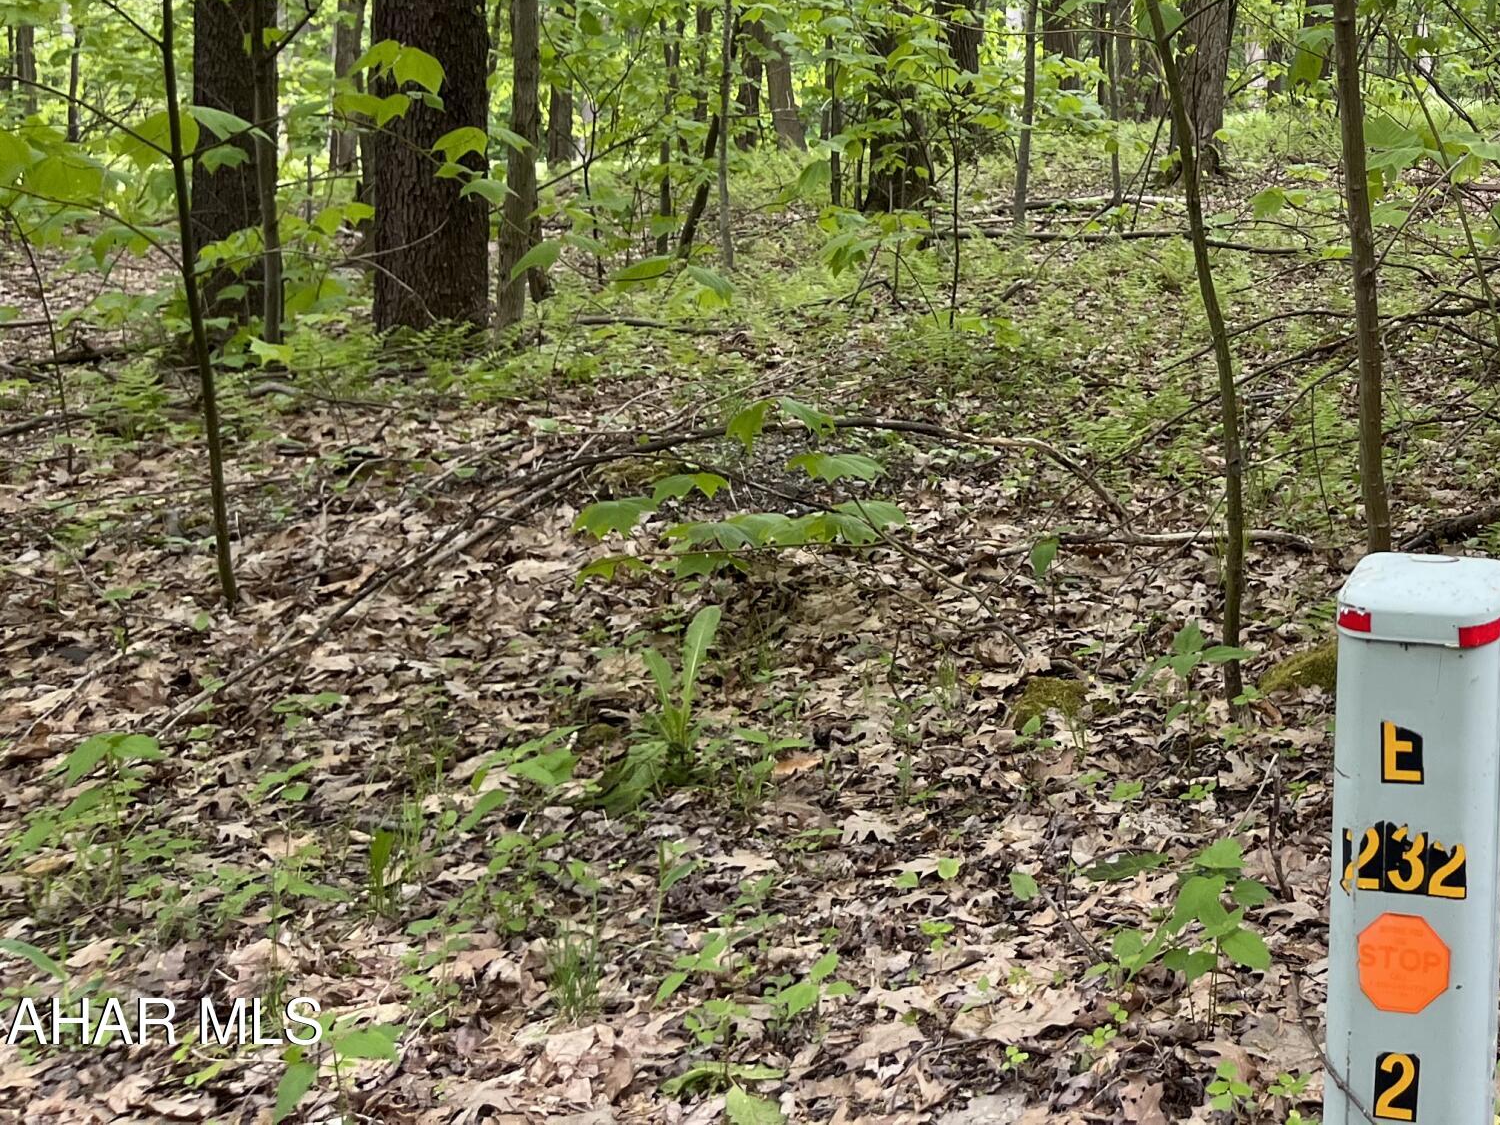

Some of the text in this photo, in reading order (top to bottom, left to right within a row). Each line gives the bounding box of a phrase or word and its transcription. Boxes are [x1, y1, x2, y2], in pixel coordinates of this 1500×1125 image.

[1383, 720, 1422, 782] E
[1341, 826, 1466, 898] 232
[1359, 944, 1441, 973] STOP
[1375, 1052, 1415, 1121] 2
